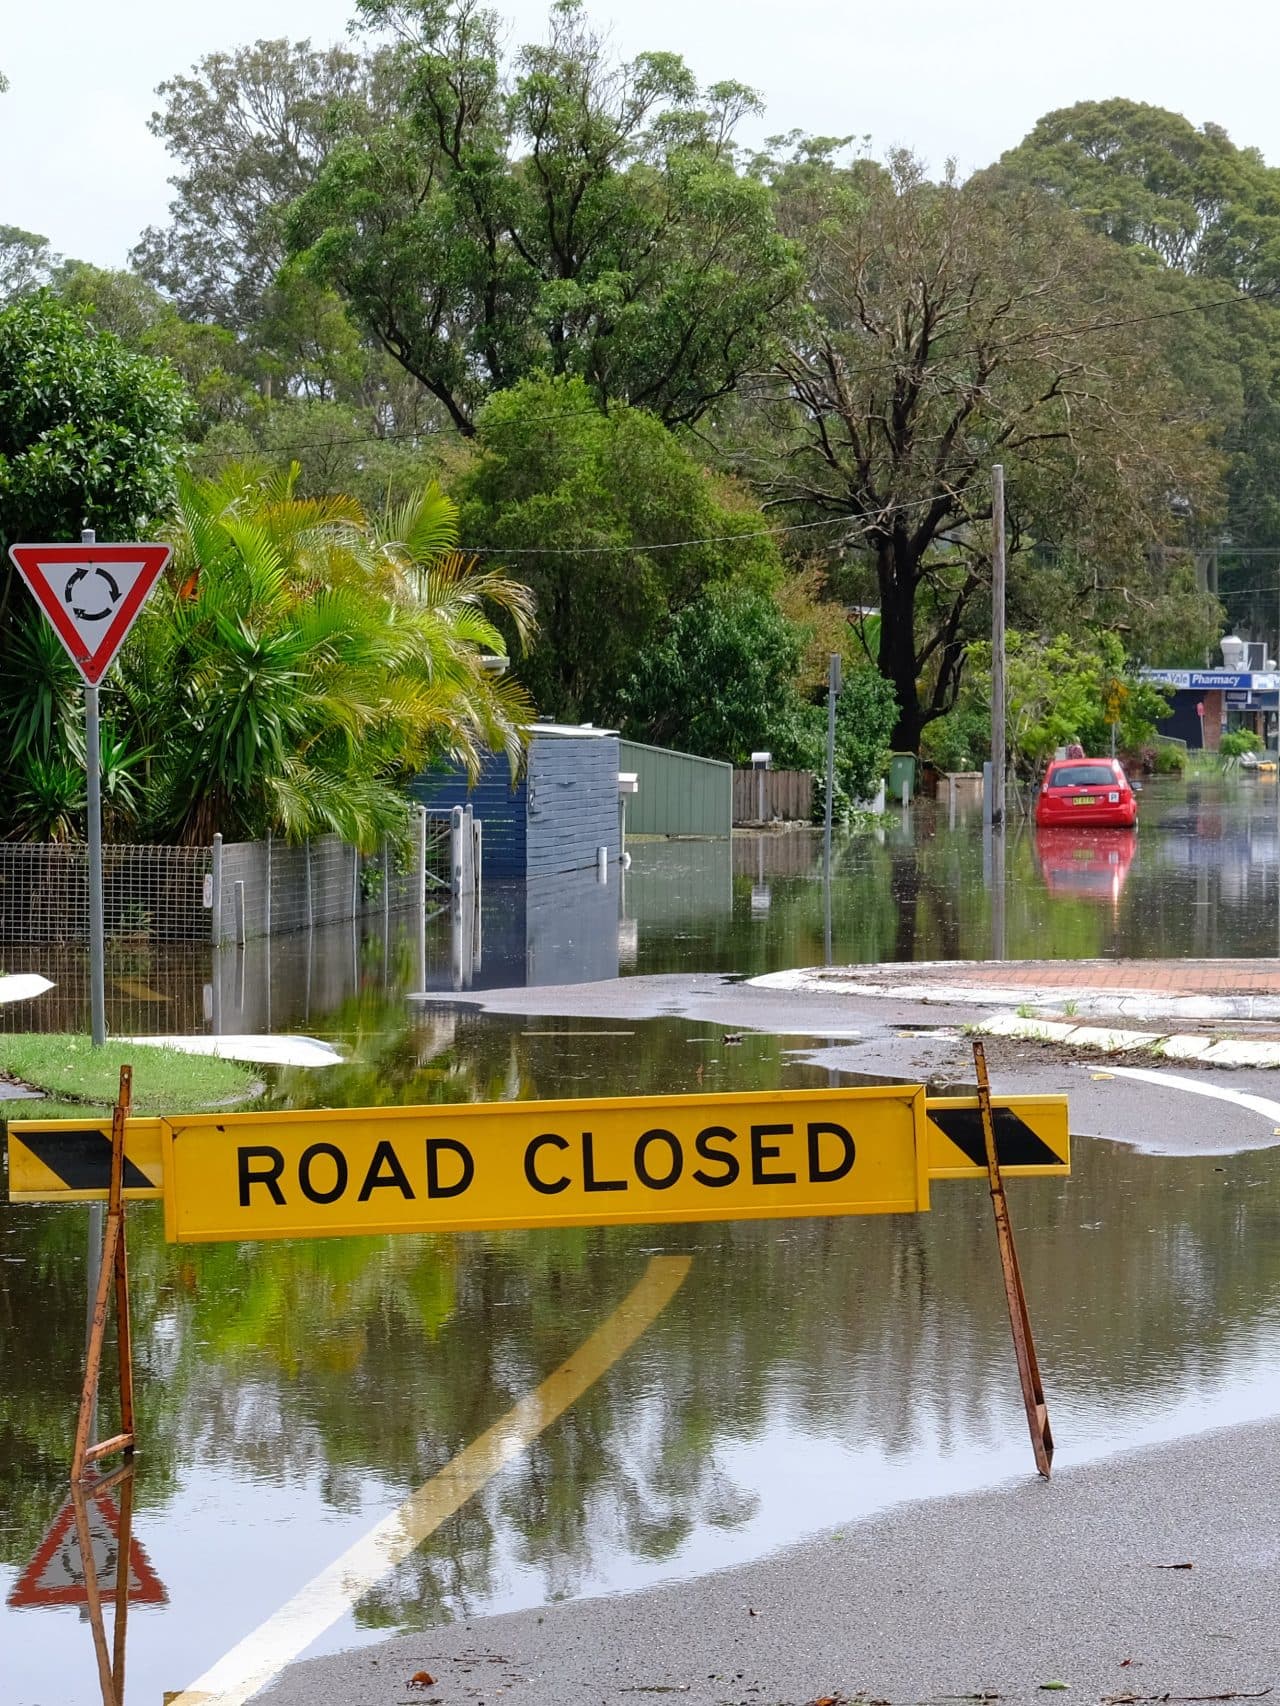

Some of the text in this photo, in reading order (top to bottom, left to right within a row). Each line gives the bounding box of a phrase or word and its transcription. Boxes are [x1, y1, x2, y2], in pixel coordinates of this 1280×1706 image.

[1170, 672, 1188, 684] Vale
[1192, 674, 1240, 687] Pharmacy
[237, 1121, 857, 1207] ROAD CLOSED
